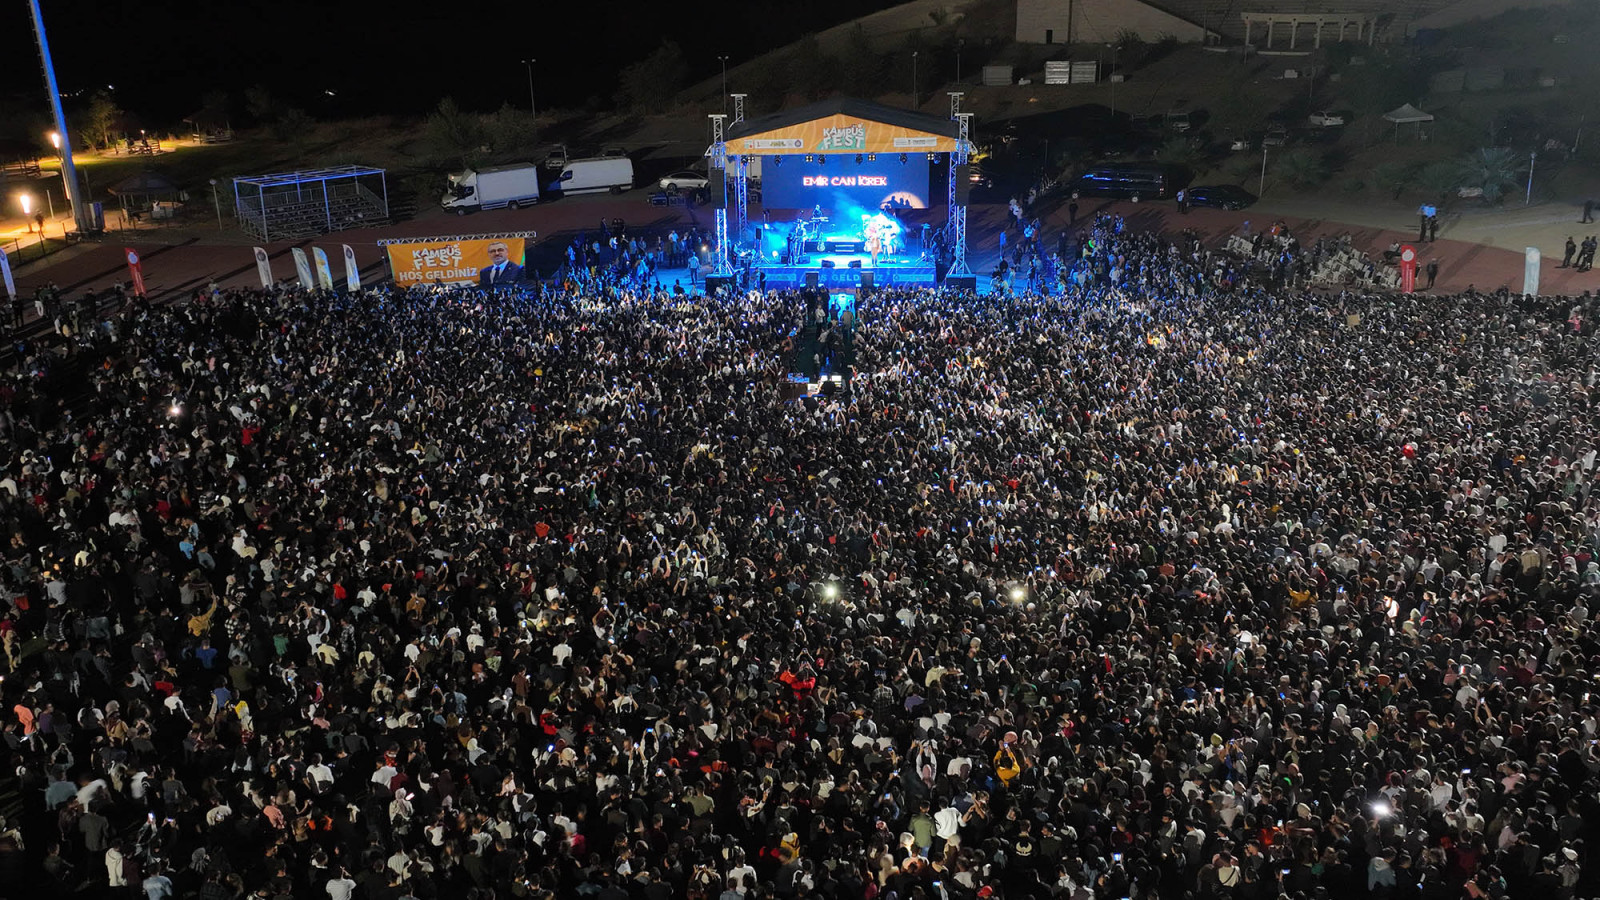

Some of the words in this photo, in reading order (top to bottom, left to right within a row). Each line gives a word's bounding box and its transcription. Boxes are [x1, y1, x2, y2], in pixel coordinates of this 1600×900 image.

[823, 135, 864, 149] FEST
[830, 176, 856, 186] CAN
[413, 256, 462, 270] FEST
[426, 267, 477, 279] GELDİNİZ
